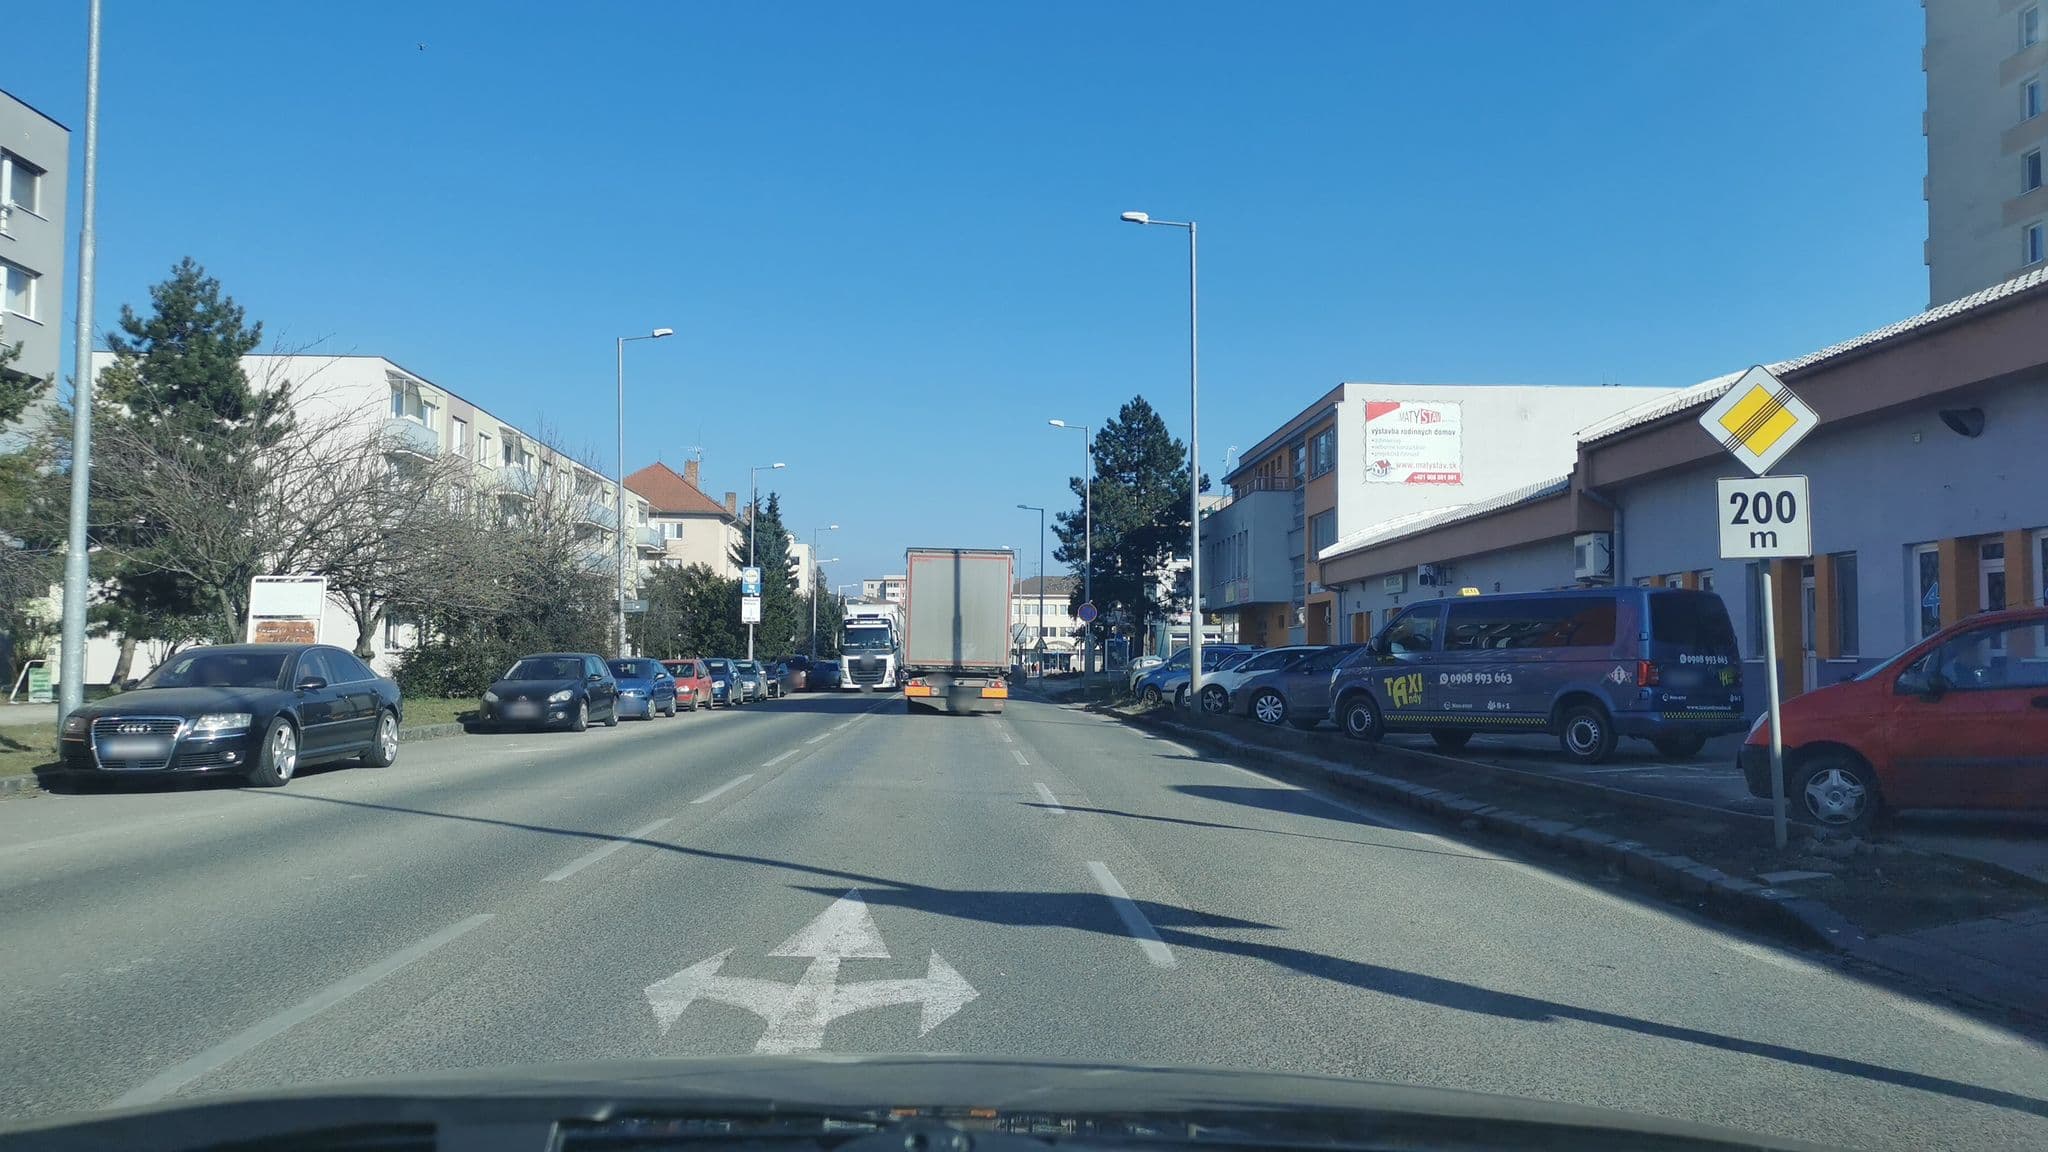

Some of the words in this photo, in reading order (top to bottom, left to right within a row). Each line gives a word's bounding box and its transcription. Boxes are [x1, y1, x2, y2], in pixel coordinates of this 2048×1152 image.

[1371, 427, 1400, 436] výstavba
[1730, 490, 1796, 525] 200
[1750, 531, 1778, 549] m
[1450, 673, 1473, 684] 0908
[1474, 673, 1493, 684] 993
[1494, 673, 1513, 684] 663
[1384, 673, 1423, 708] TAXI
